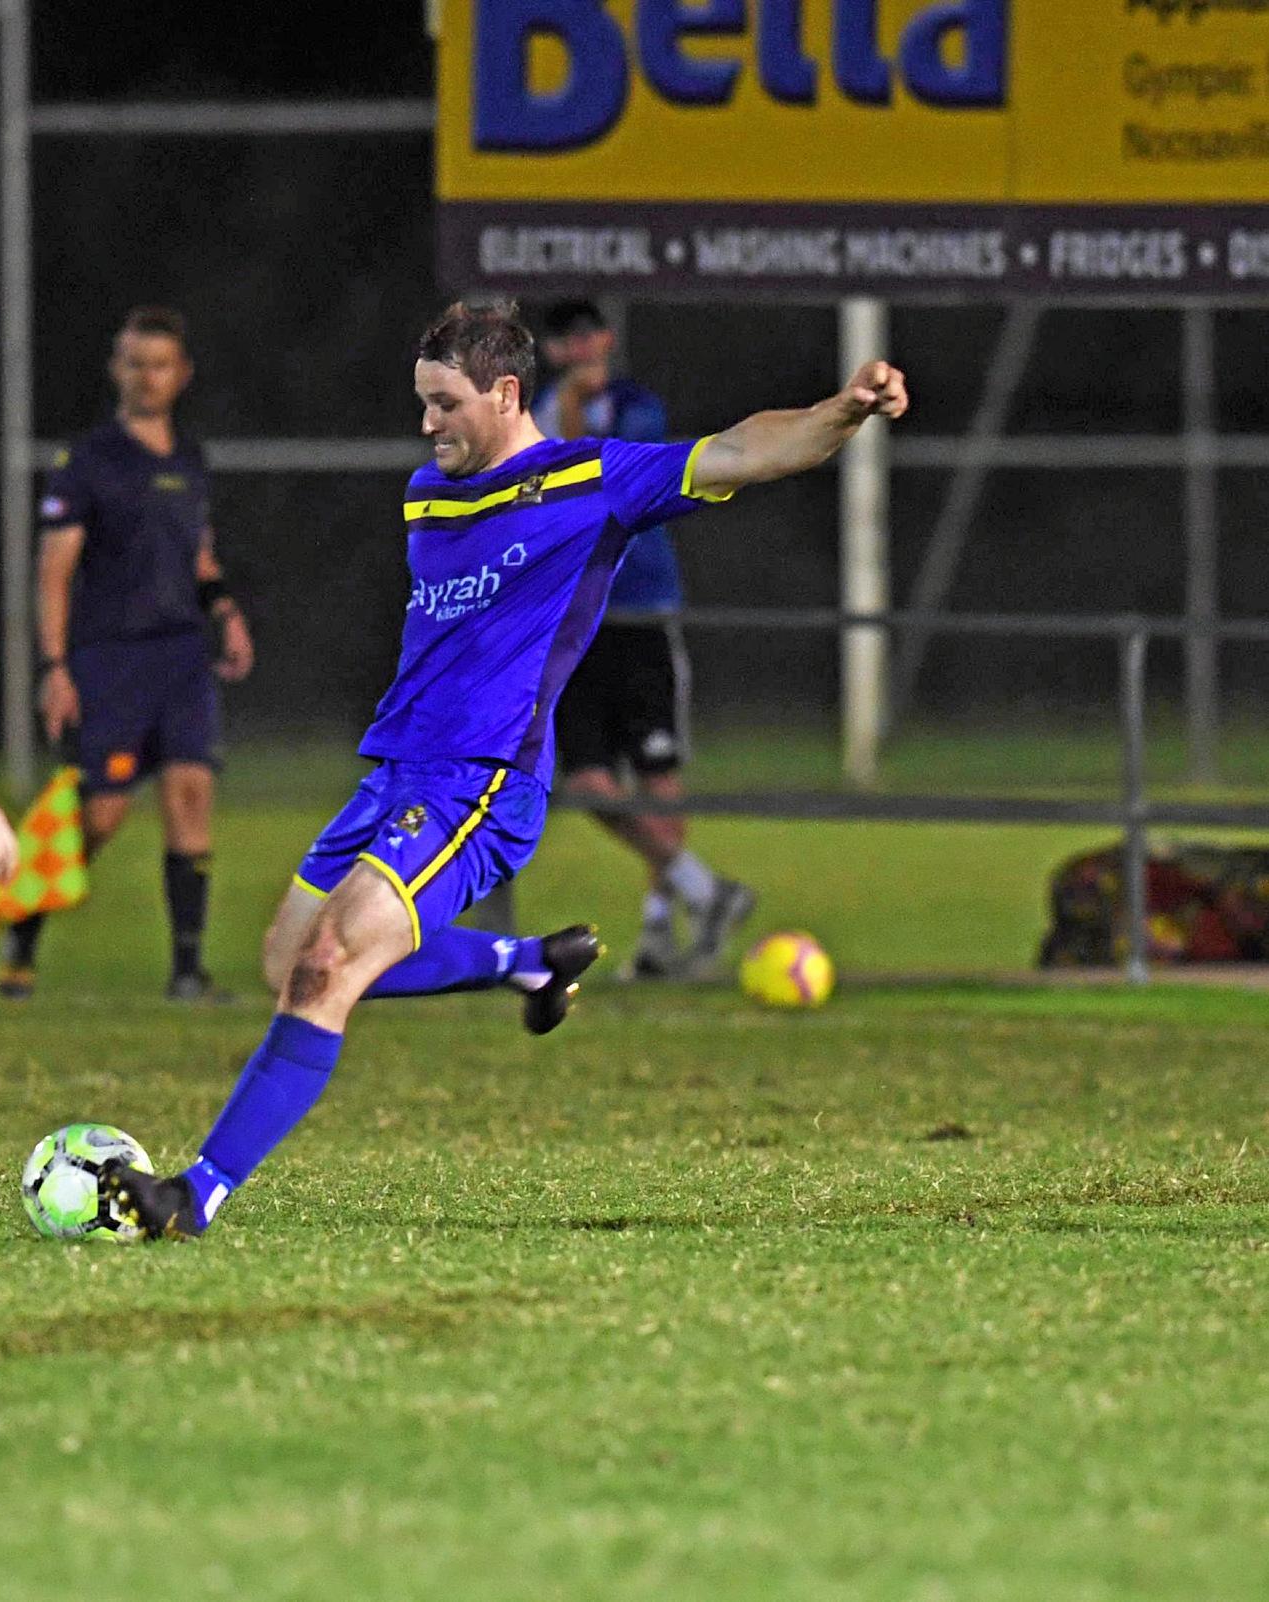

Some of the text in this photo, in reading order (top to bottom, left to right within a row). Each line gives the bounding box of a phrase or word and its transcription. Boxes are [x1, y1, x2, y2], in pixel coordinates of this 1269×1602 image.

[479, 228, 656, 274] ELECTRICAL
[694, 226, 839, 277] WASHING
[844, 228, 1007, 277] MACHINES
[1048, 228, 1187, 279] FRIDGES
[435, 599, 491, 622] Kitchs
